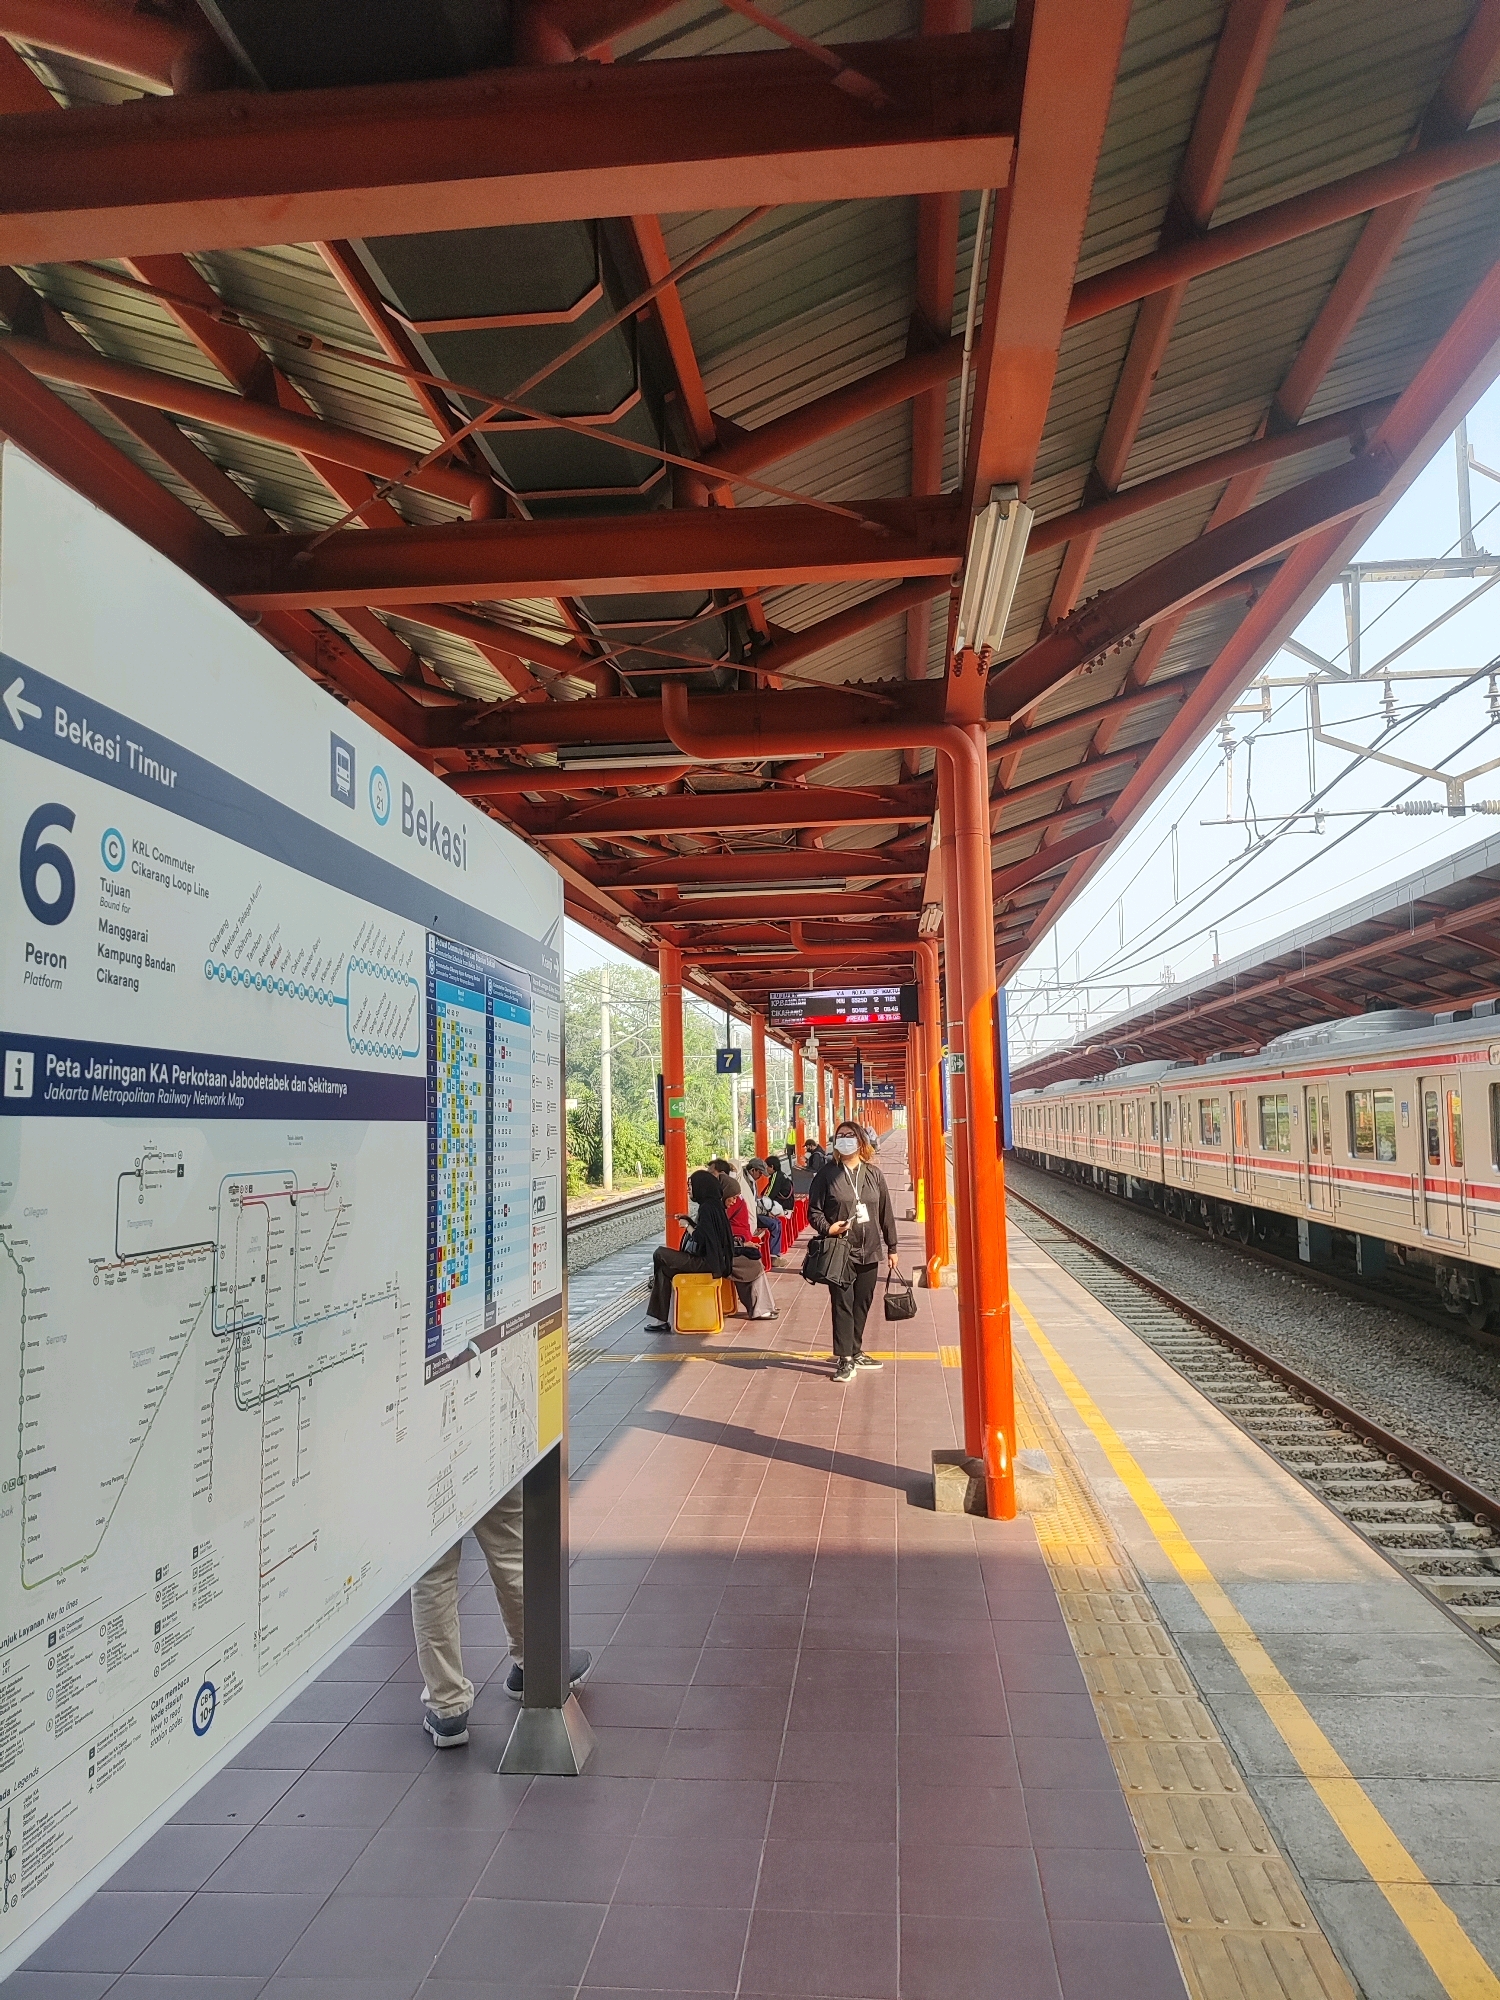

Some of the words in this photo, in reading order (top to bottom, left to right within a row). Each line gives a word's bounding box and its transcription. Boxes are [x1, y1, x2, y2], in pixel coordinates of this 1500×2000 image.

[55, 706, 120, 763] Bekasi
[126, 740, 178, 788] Timur
[378, 780, 382, 792] C
[376, 795, 384, 812] 21
[402, 781, 468, 871] Bekasi
[108, 840, 119, 859] C
[132, 838, 150, 858] KRL
[152, 846, 195, 875] Commuter
[19, 802, 76, 926] 6
[100, 876, 131, 899] Tujuan
[131, 860, 170, 888] Cikarang
[172, 873, 192, 896] Loop
[193, 880, 210, 899] Line
[100, 896, 120, 912] Bound
[121, 902, 131, 914] for
[98, 917, 149, 944] Manggarai
[209, 919, 229, 953] Cikarang
[222, 923, 239, 958] Metland
[25, 942, 67, 970] Peron
[234, 928, 252, 960] Cibitung
[246, 933, 263, 962] Tambun
[97, 942, 143, 969] Kampung
[144, 954, 176, 973] Bandan
[24, 971, 63, 990] Platform
[96, 968, 140, 992] Cikarang
[724, 1054, 734, 1068] 7
[46, 1054, 81, 1079] Peta
[85, 1056, 146, 1086] Jaringan
[150, 1063, 169, 1084] KA
[172, 1065, 227, 1088] Perkotaan
[230, 1069, 289, 1092] Jabodetabek
[291, 1078, 307, 1093] dan
[308, 1077, 348, 1098] Sekitarnya
[44, 1083, 89, 1102] Jakarta
[92, 1086, 155, 1106] Metropolitan
[157, 1089, 192, 1107] Railway
[194, 1091, 226, 1106] Network
[228, 1092, 245, 1108] Map
[795, 1094, 802, 1104] 7
[24, 1207, 48, 1218] Cilegon
[127, 1220, 153, 1229] Tangerang
[46, 1334, 67, 1345] Serang
[129, 1346, 156, 1359] Tangerang
[132, 1357, 152, 1369] Selatan
[19, 1618, 44, 1638] Layanan
[47, 1610, 58, 1622] Key
[150, 1696, 163, 1710] Cara
[164, 1677, 190, 1700] membaca
[200, 1693, 209, 1707] CB
[150, 1708, 164, 1723] kode
[165, 1693, 183, 1712] stasiun
[200, 1707, 208, 1723] 10
[14, 1766, 39, 1791] Legends
